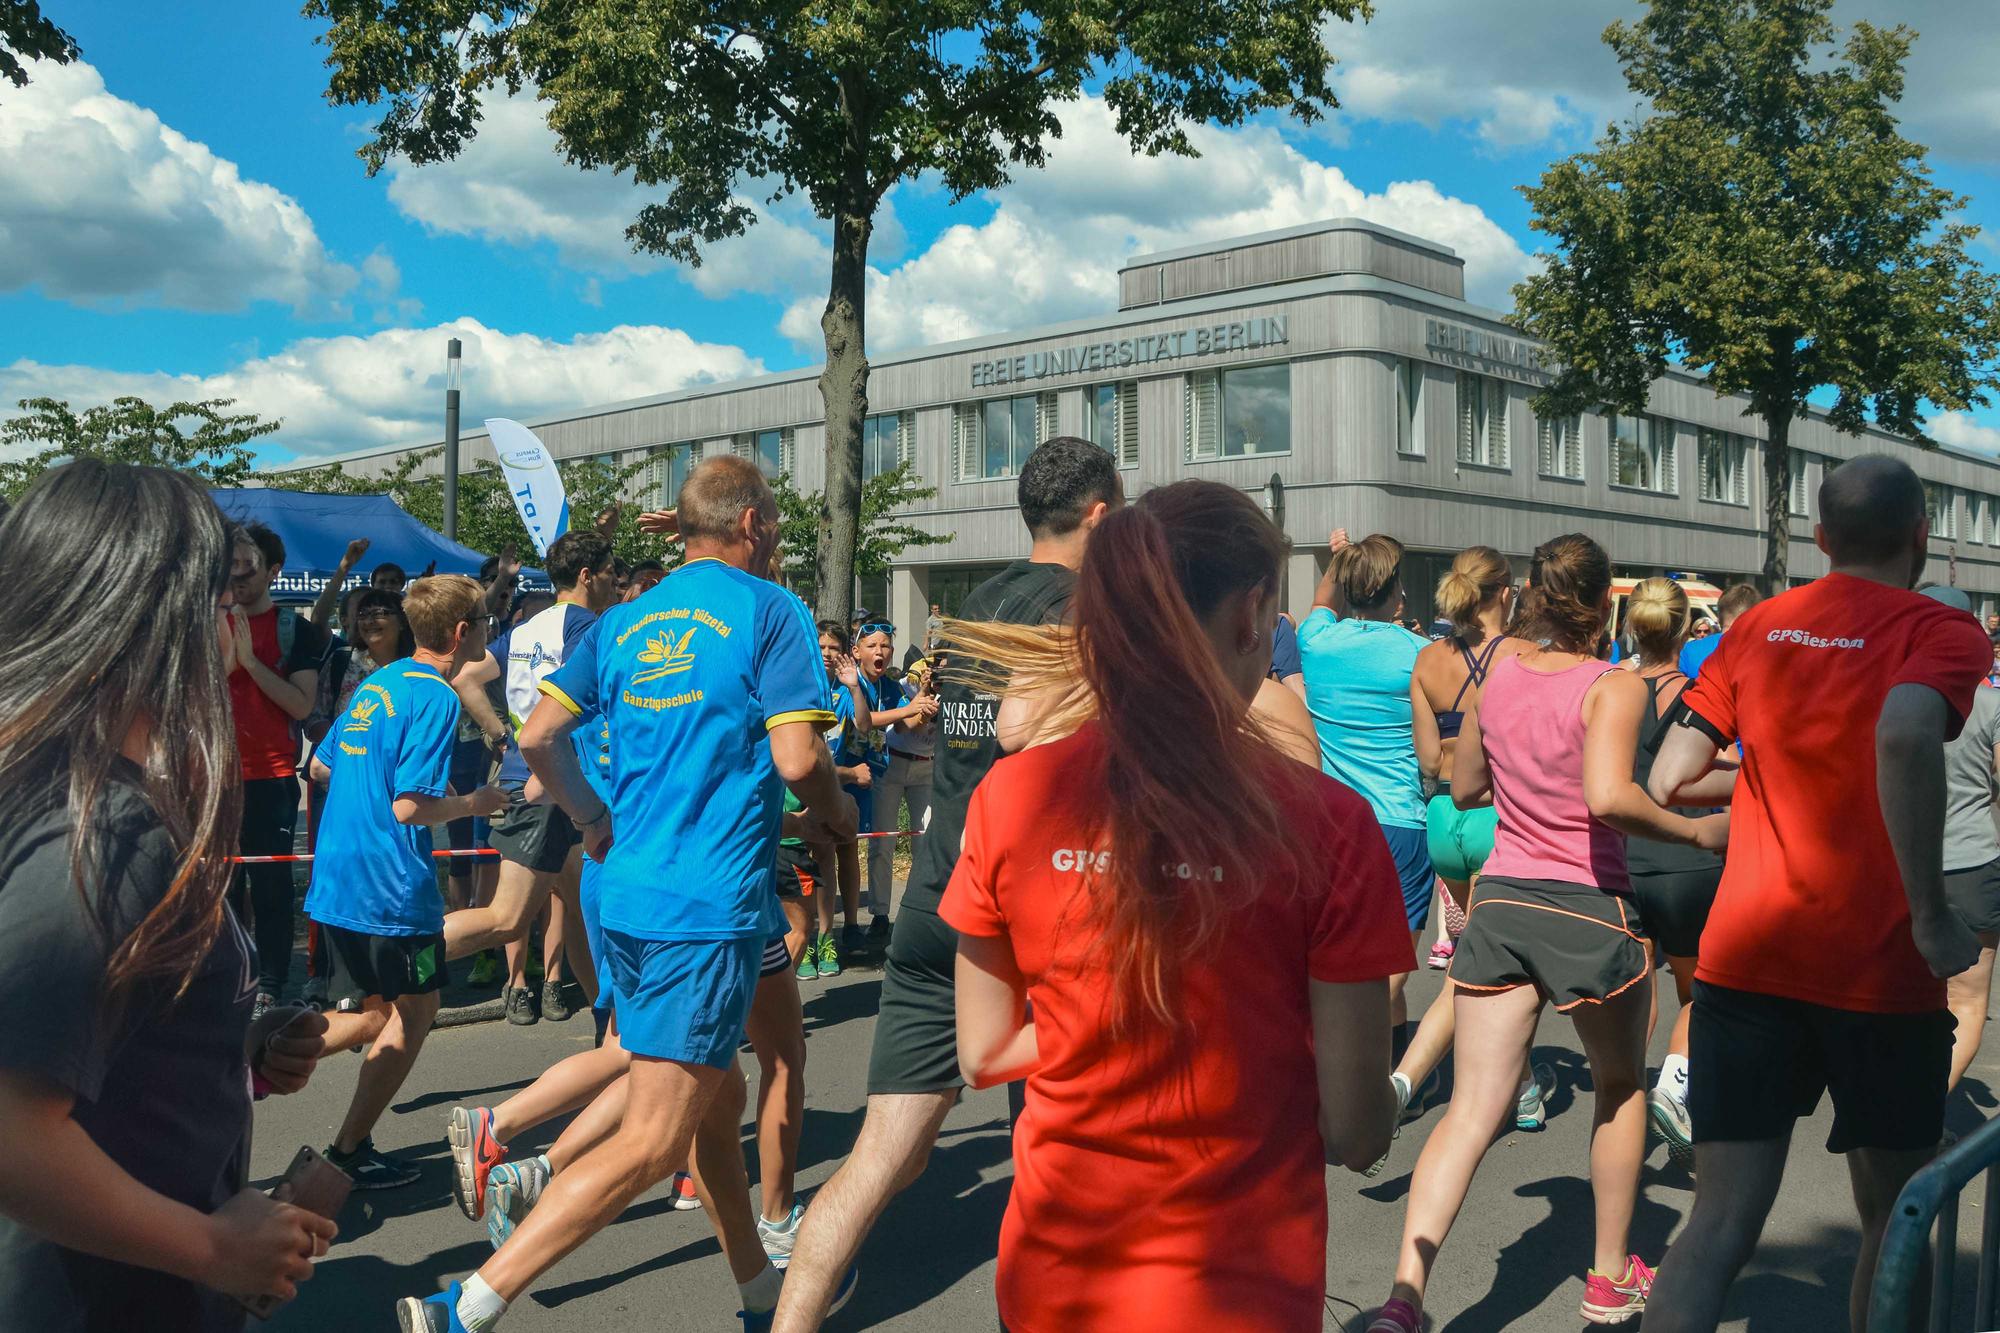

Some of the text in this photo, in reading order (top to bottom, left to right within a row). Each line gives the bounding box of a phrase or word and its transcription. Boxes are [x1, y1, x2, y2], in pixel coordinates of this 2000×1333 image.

[971, 314, 1290, 387] FREIE UNIVERSITÄT BERLIN
[692, 608, 733, 639] Sülzetal
[1766, 629, 1865, 648] GPSies.com
[623, 689, 703, 712] Ganztgsschule
[942, 702, 994, 720] NORDEA
[943, 718, 998, 737] FONDEN
